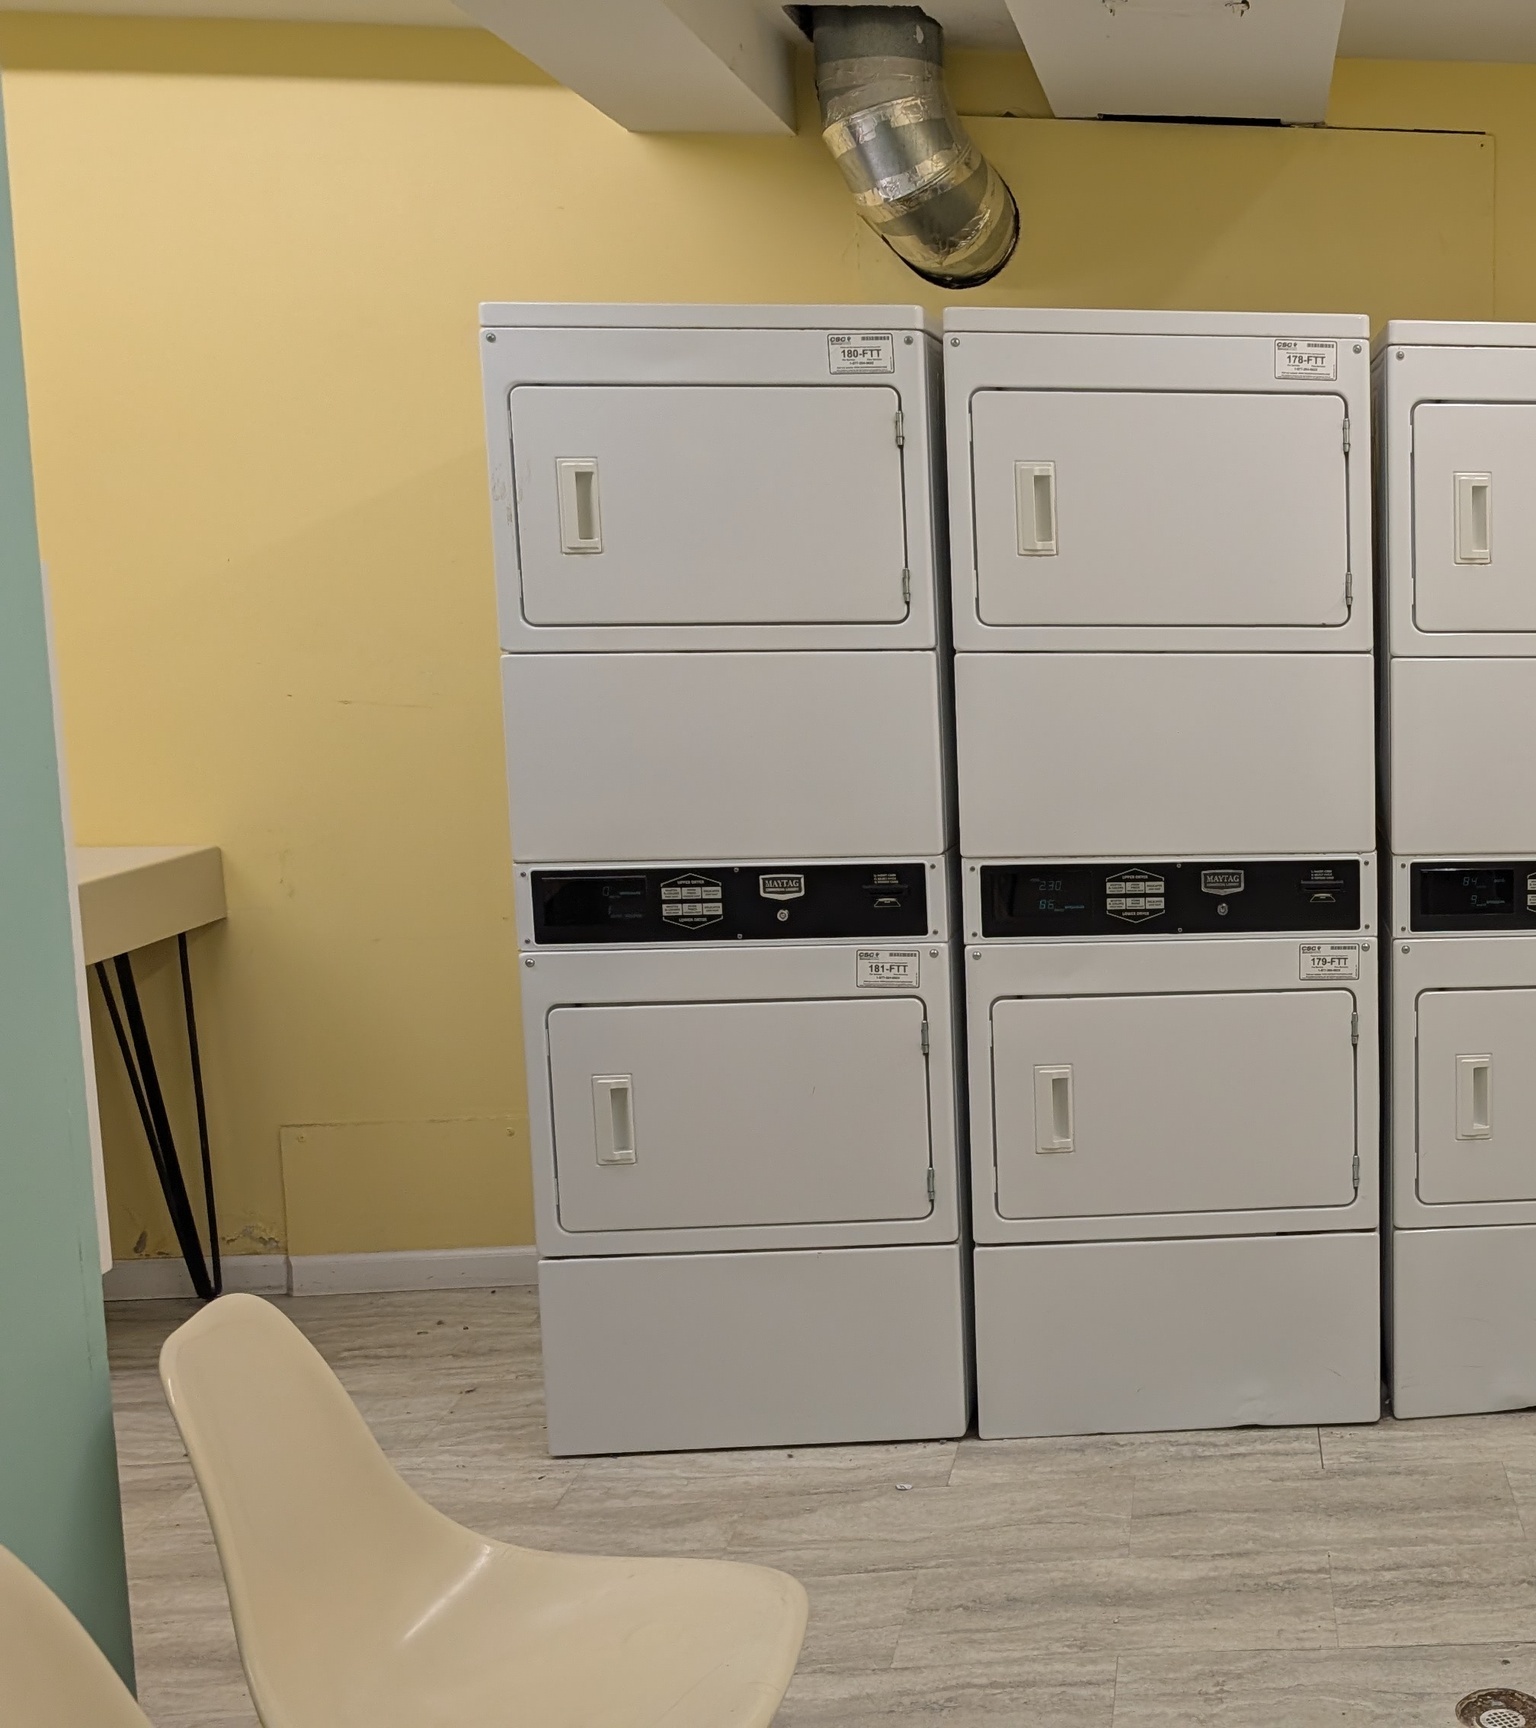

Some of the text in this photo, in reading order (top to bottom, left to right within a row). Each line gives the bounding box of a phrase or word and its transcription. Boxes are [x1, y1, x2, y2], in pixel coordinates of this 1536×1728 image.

[841, 349, 881, 358] 180-FTT
[1287, 355, 1326, 365] 178-FTT
[1206, 875, 1239, 883] MAYTAG
[765, 880, 799, 888] MAYTAG
[1311, 957, 1348, 966] 179-FTT
[869, 964, 908, 973] 181-FTT
